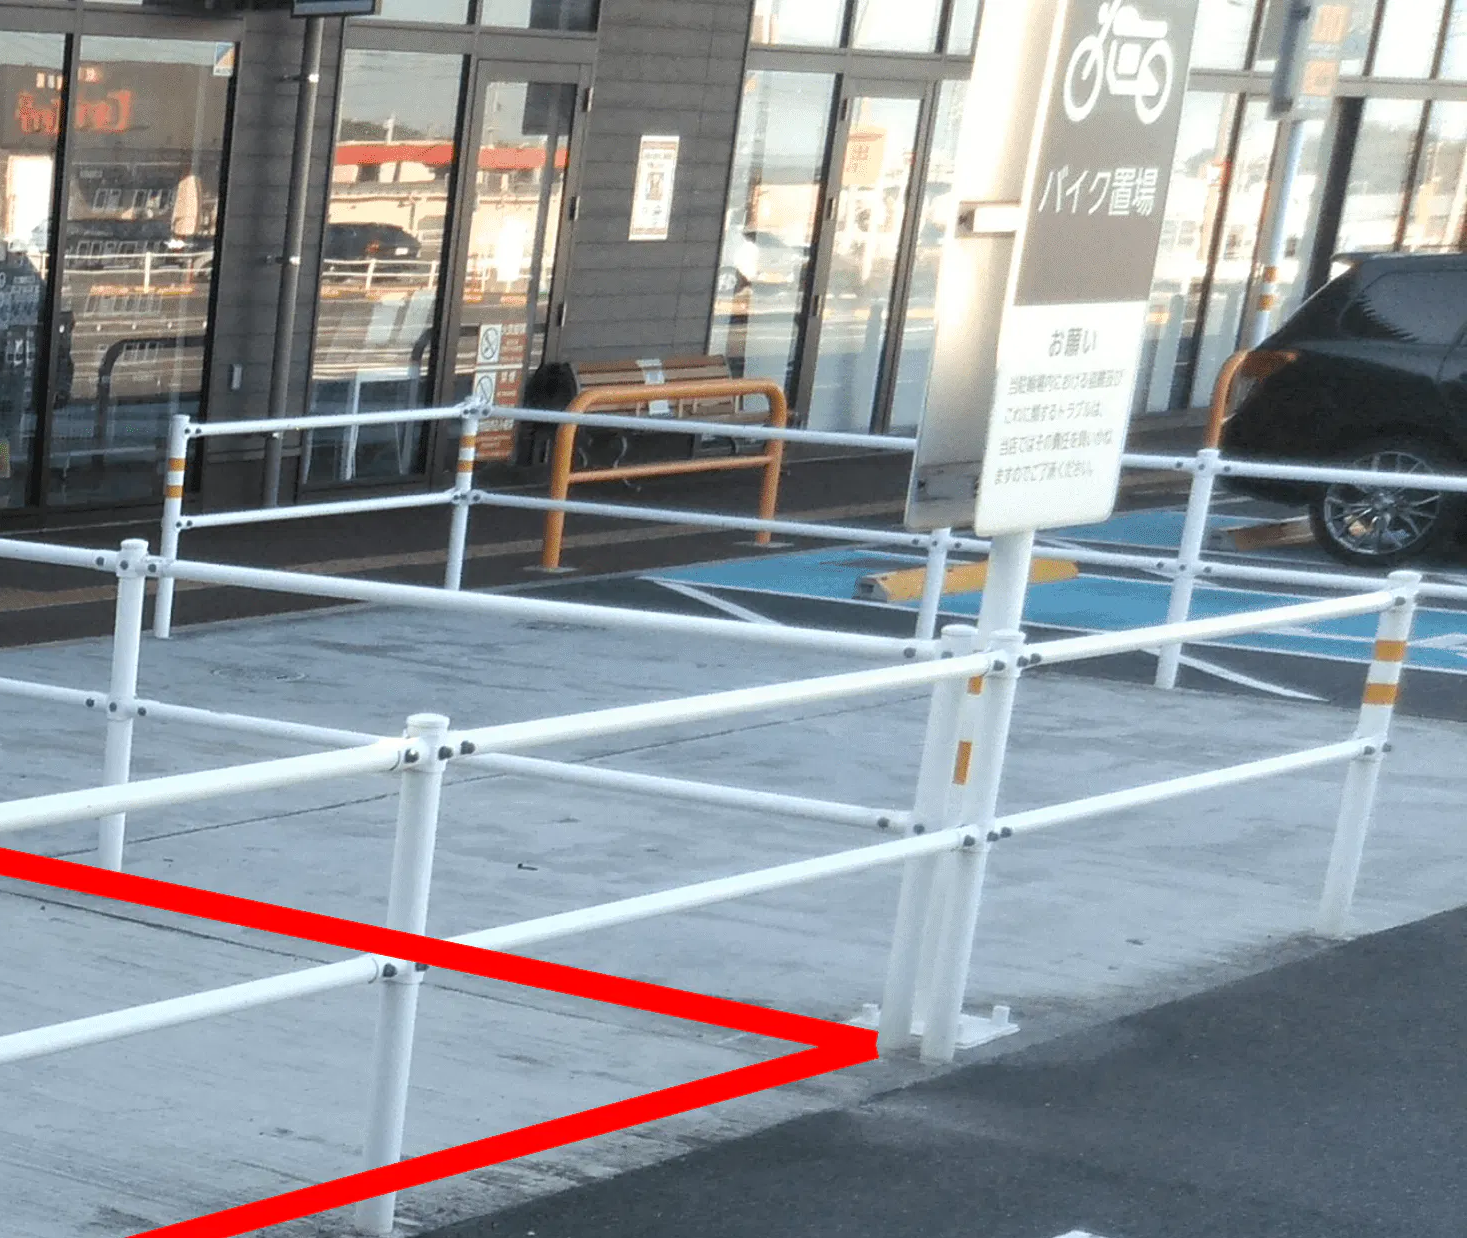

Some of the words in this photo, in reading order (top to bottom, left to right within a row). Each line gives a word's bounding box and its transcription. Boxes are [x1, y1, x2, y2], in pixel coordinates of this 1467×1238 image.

[1038, 166, 1158, 215] バイク置場
[1048, 327, 1097, 357] お願い
